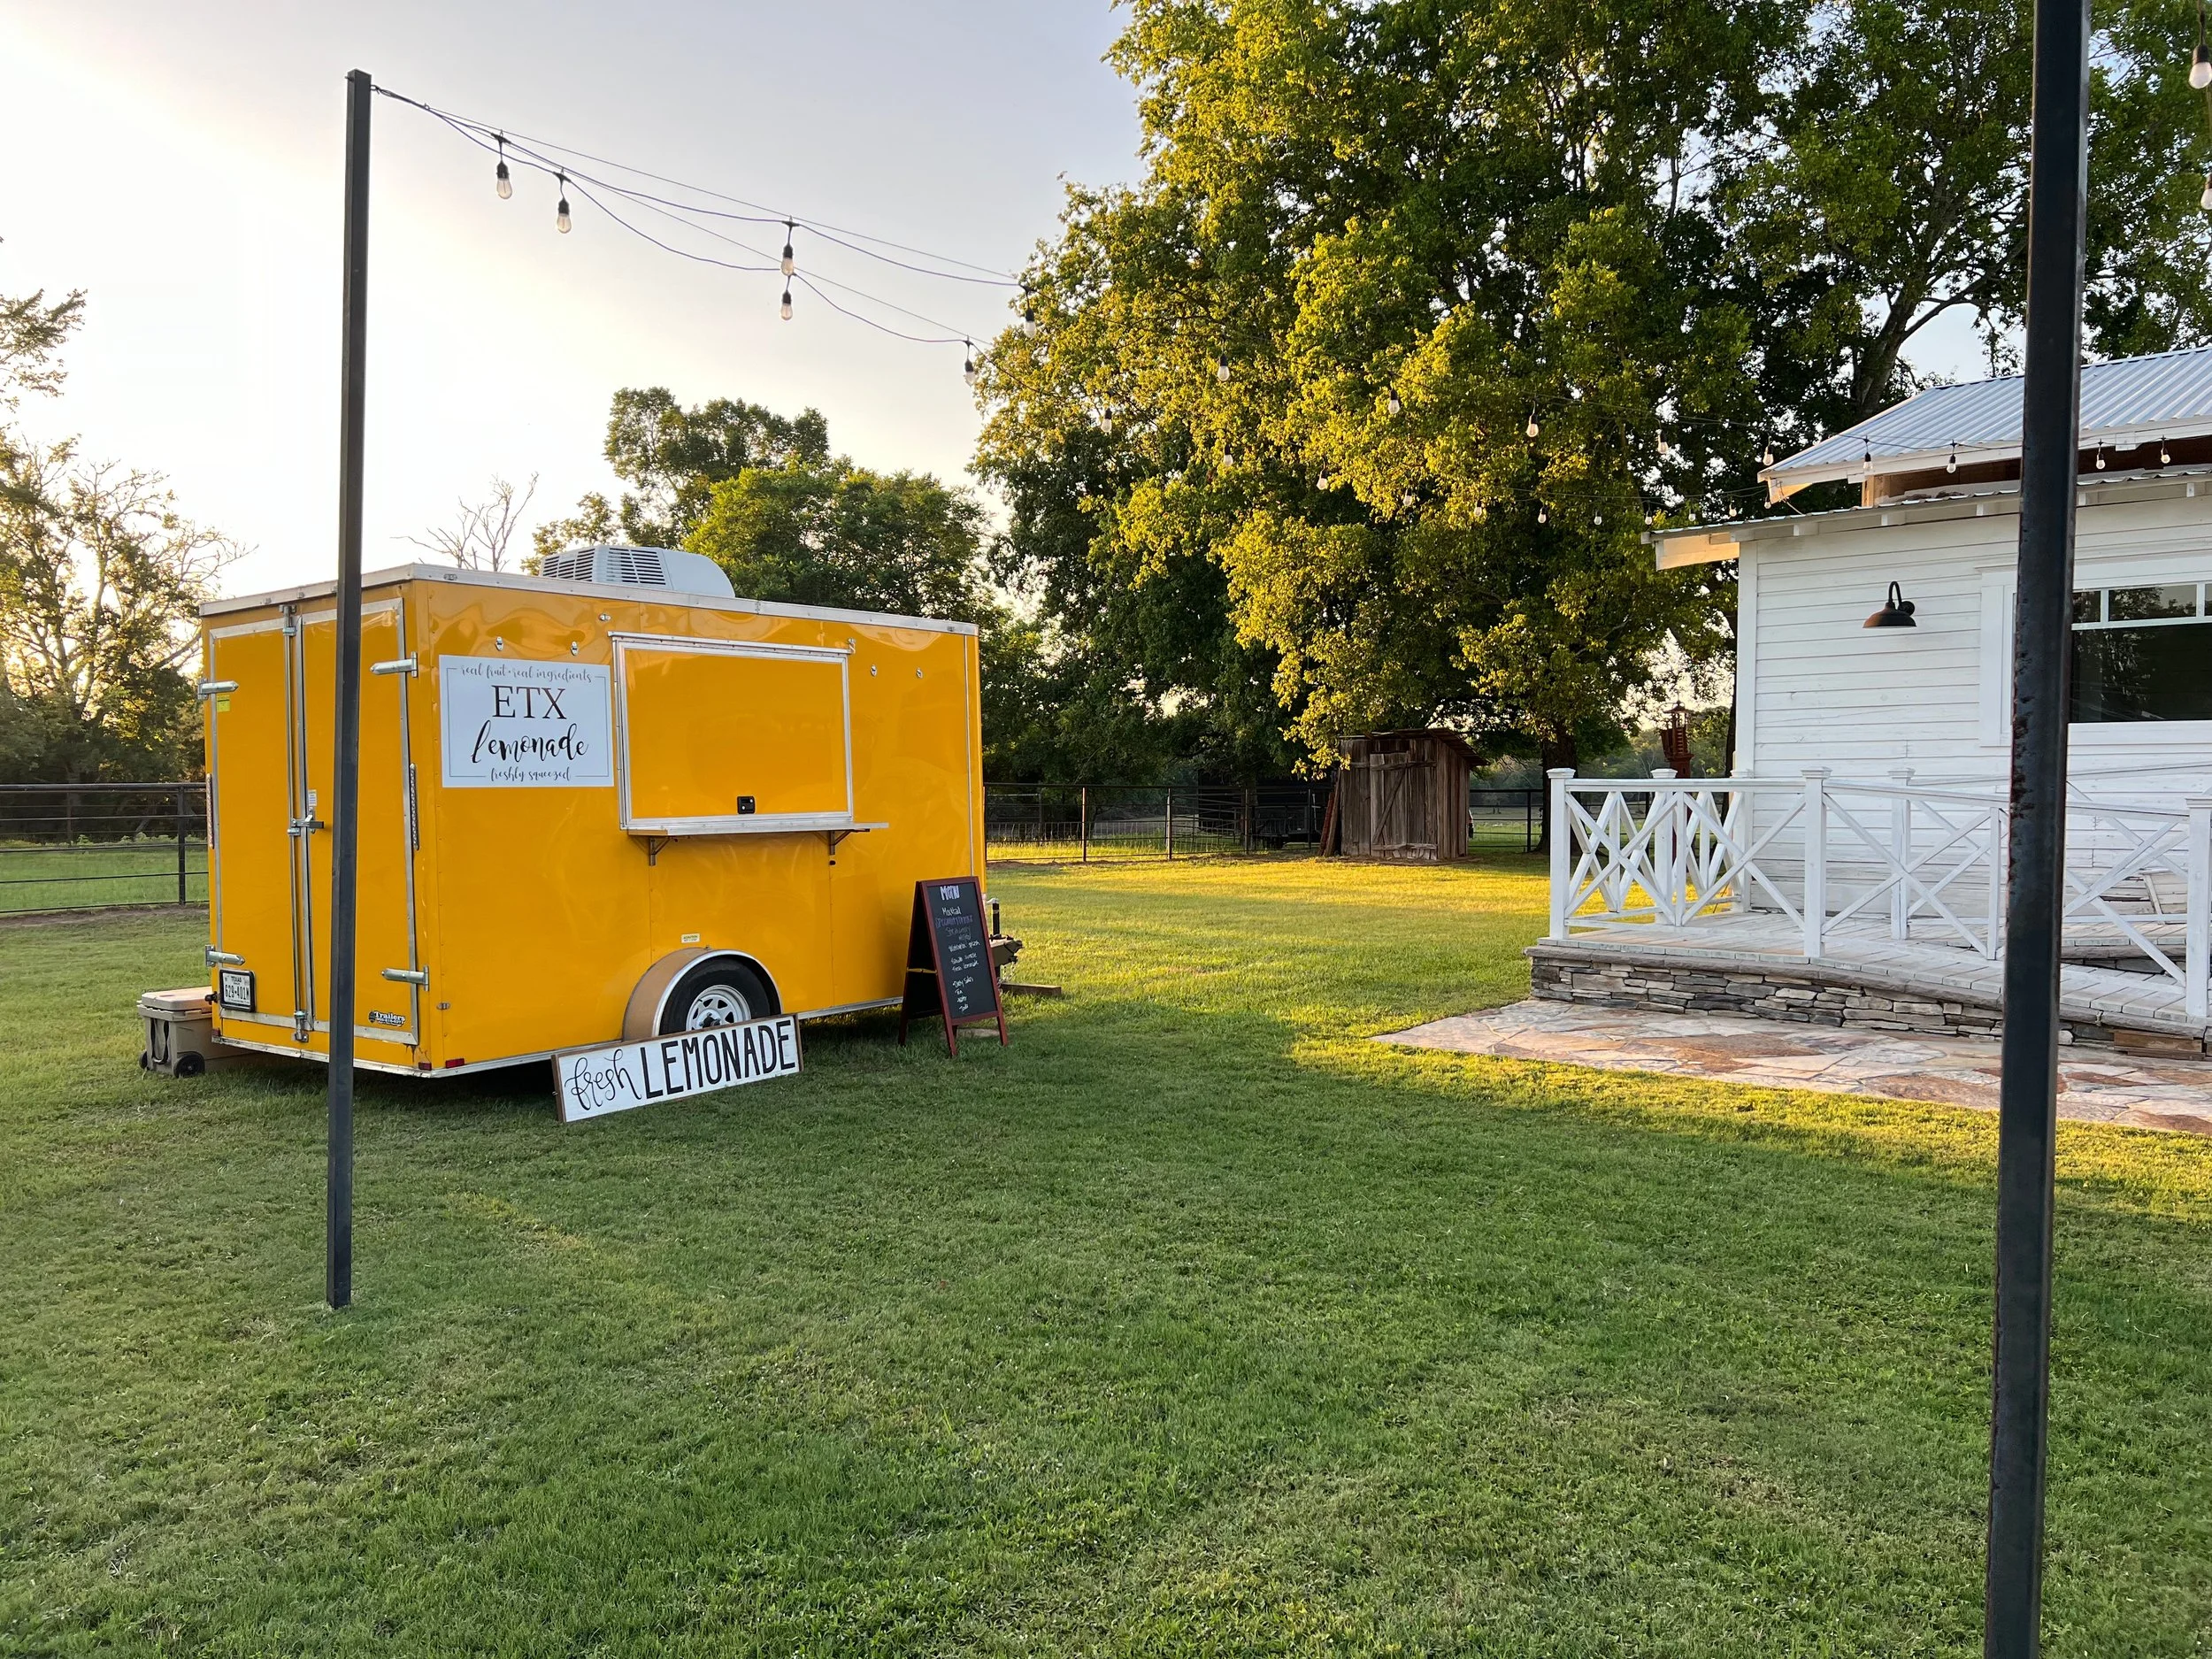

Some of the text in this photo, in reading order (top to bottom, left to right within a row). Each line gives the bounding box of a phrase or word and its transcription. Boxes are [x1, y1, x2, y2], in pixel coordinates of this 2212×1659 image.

[461, 663, 592, 682] real fruit real ingredients
[491, 685, 567, 719] ETX
[471, 719, 589, 764] lemonade
[490, 766, 572, 781] freshly squeezed
[564, 1019, 796, 1111] fresh LEMONADE
